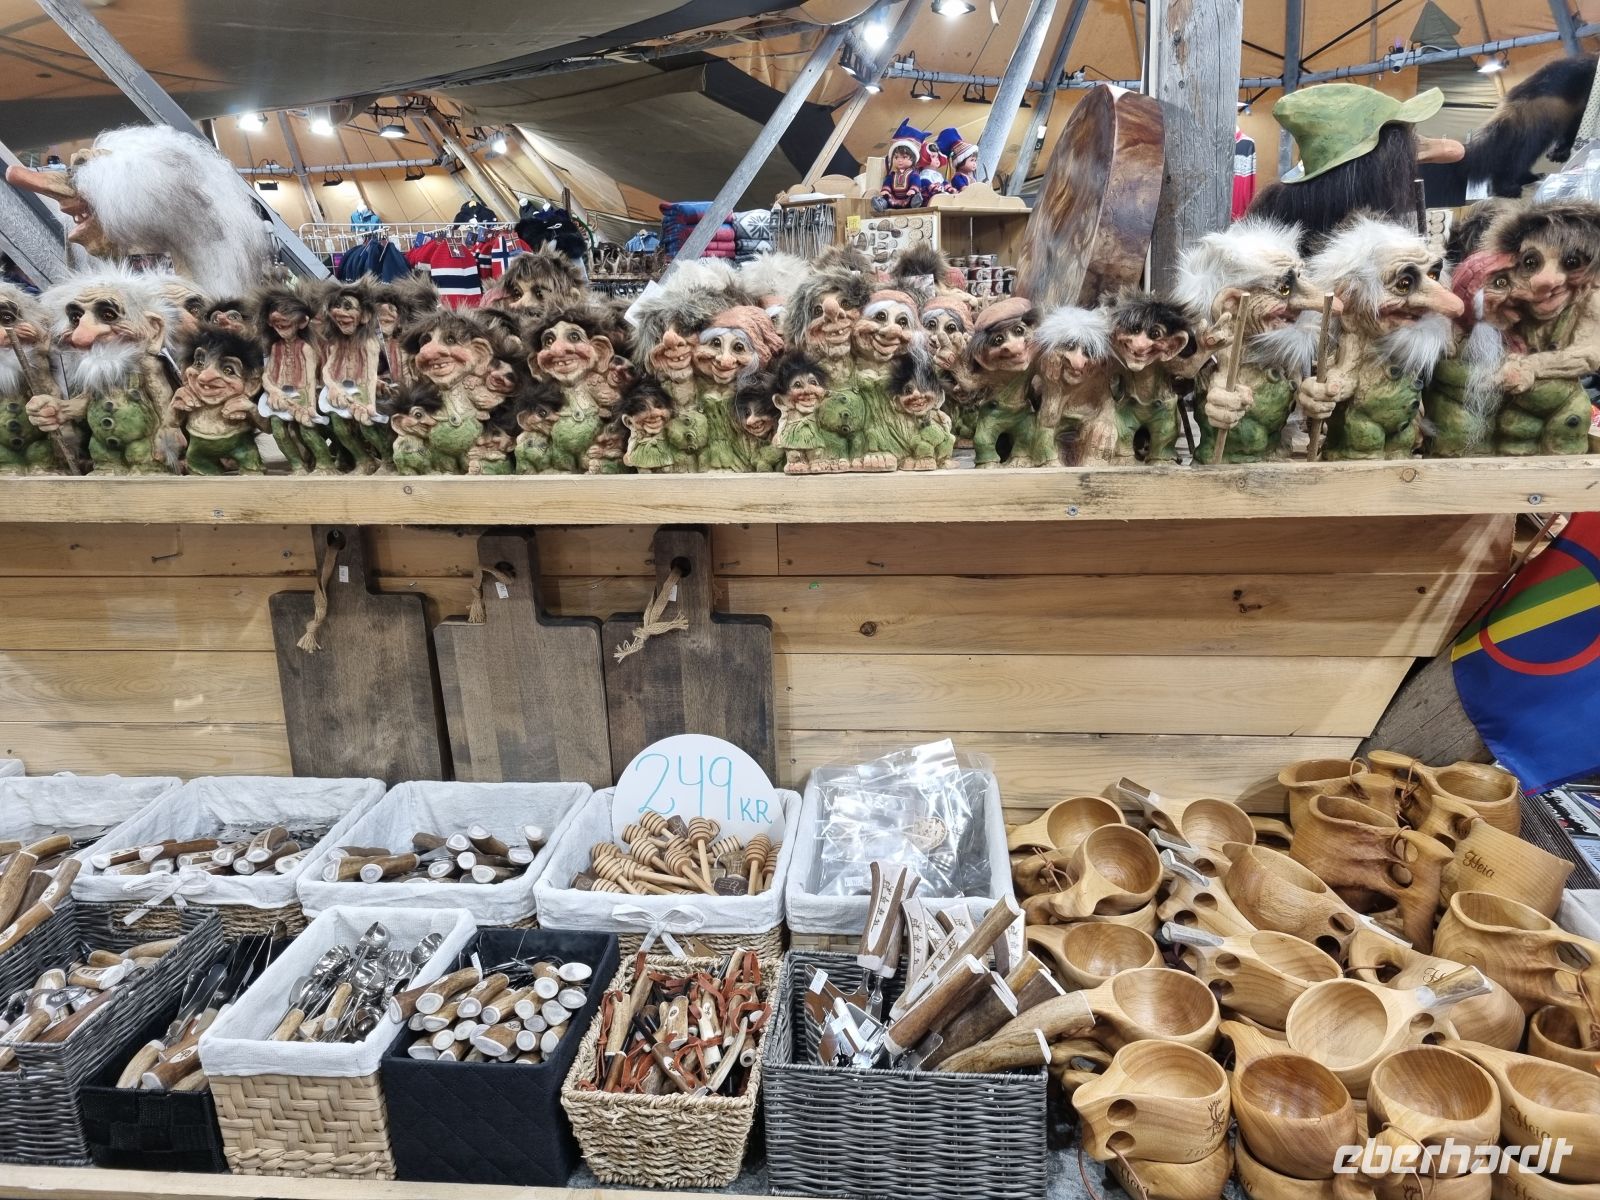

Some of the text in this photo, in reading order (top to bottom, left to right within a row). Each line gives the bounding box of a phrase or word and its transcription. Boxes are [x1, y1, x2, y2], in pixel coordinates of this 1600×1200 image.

[635, 753, 773, 824] 249 KR
[1462, 850, 1495, 880] Heia
